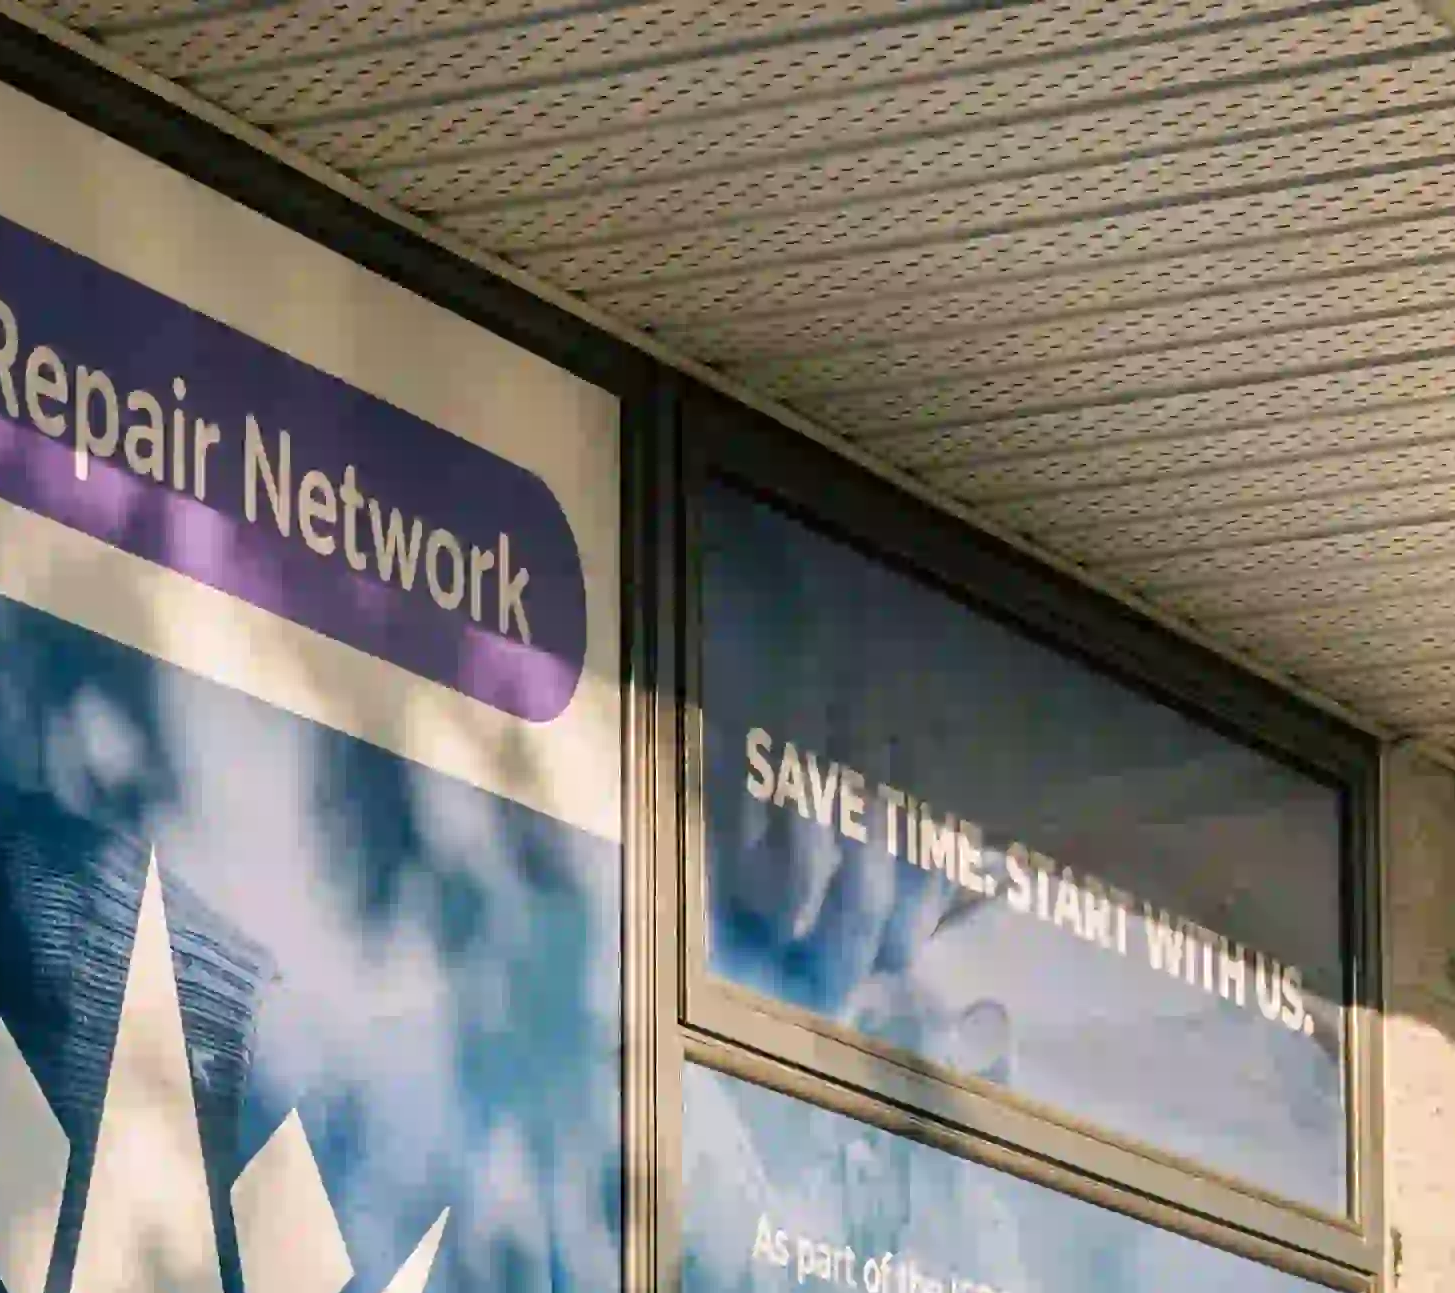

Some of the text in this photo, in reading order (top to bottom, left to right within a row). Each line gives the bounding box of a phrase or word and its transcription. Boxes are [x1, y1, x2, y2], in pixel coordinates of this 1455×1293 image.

[241, 413, 532, 646] Network
[745, 727, 1315, 1037] SAVE TIME. START WITH US.
[752, 1212, 790, 1268] As
[796, 1236, 857, 1288] part
